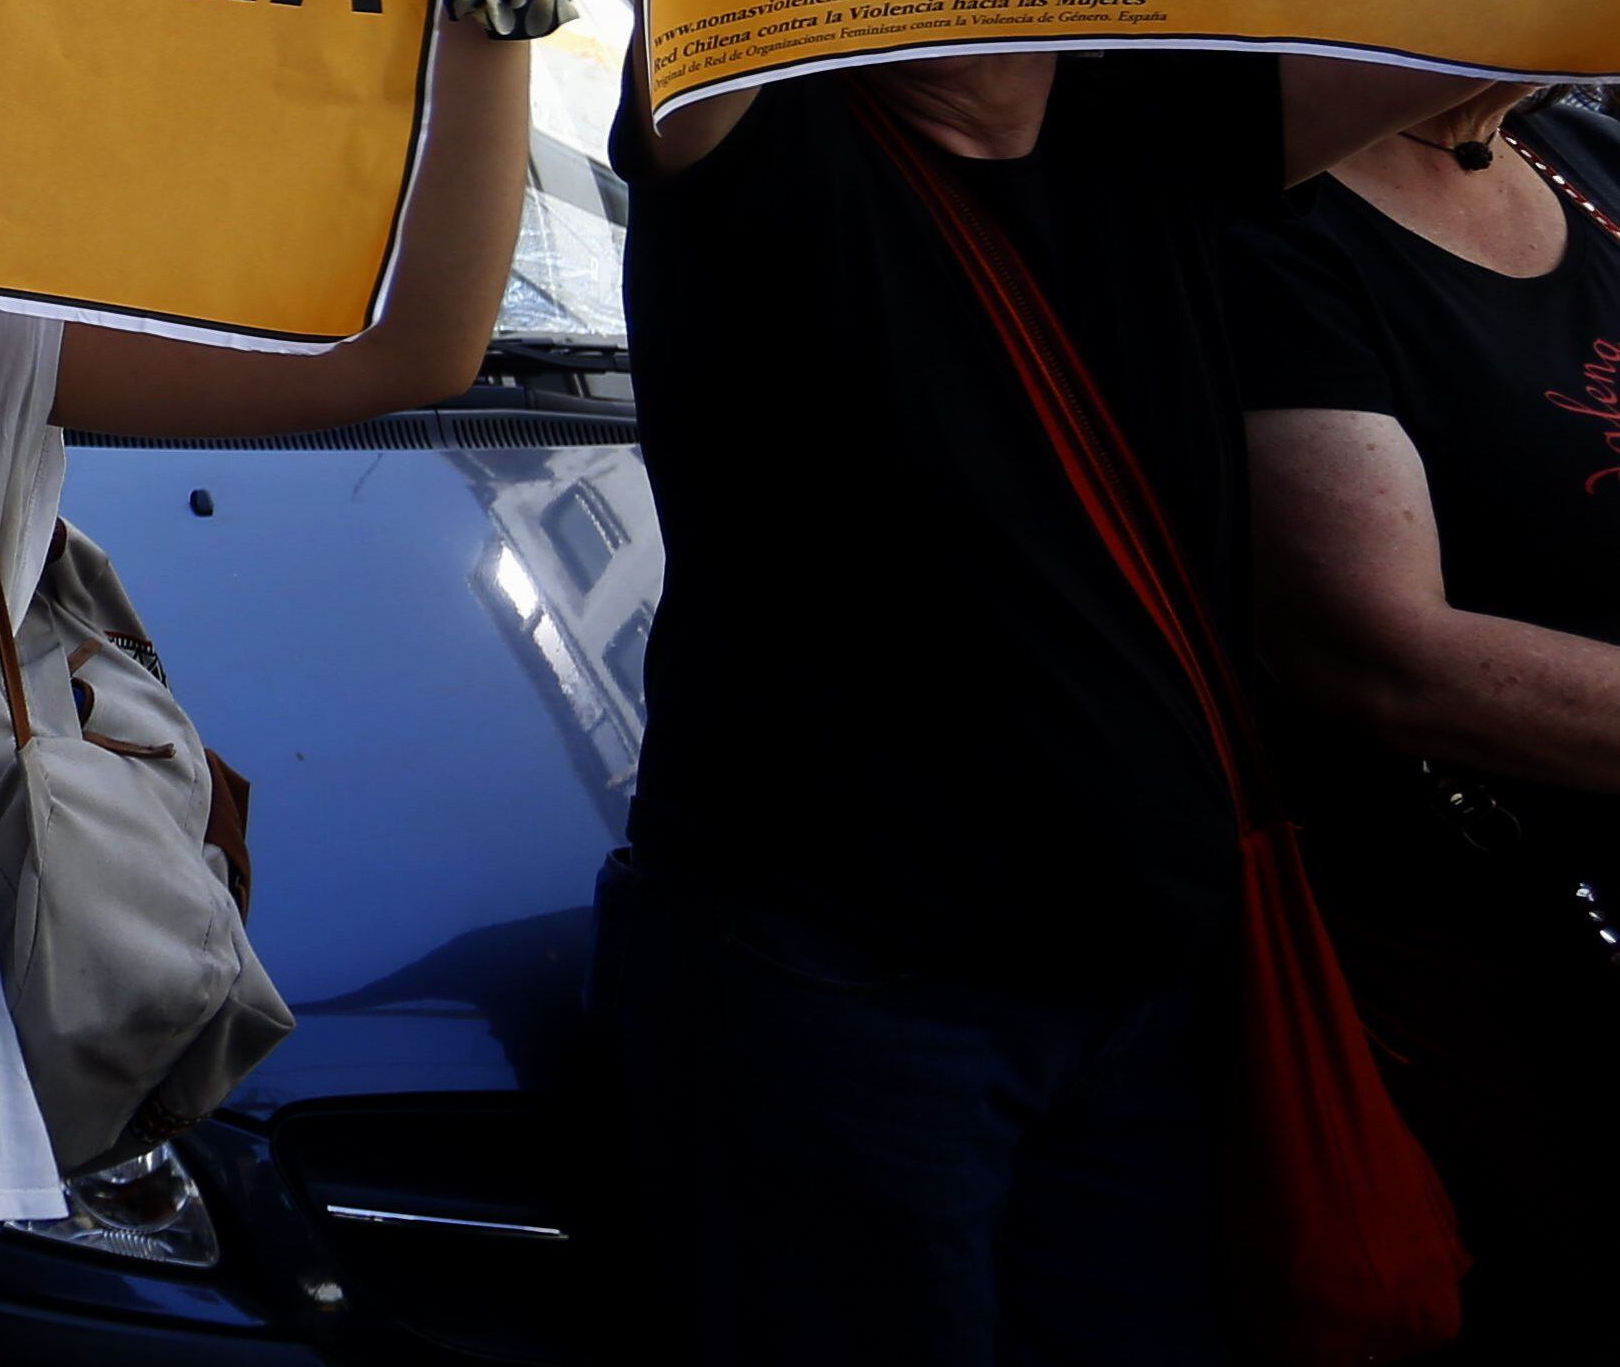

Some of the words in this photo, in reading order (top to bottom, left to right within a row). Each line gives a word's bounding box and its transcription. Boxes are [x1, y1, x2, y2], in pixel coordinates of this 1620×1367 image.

[654, 47, 678, 74] Red
[682, 31, 751, 58] Chilena
[757, 14, 819, 38] contra
[823, 10, 843, 25] la
[687, 61, 702, 73] de
[703, 55, 727, 69] Red
[728, 49, 744, 61] de
[745, 33, 836, 58] Organizaciones
[838, 23, 908, 40] Feministas
[909, 18, 952, 31] contra
[953, 15, 968, 27] la
[970, 13, 1034, 26] Violencia
[1036, 11, 1054, 24] de
[1057, 9, 1112, 24] Género.
[1117, 10, 1167, 25] España
